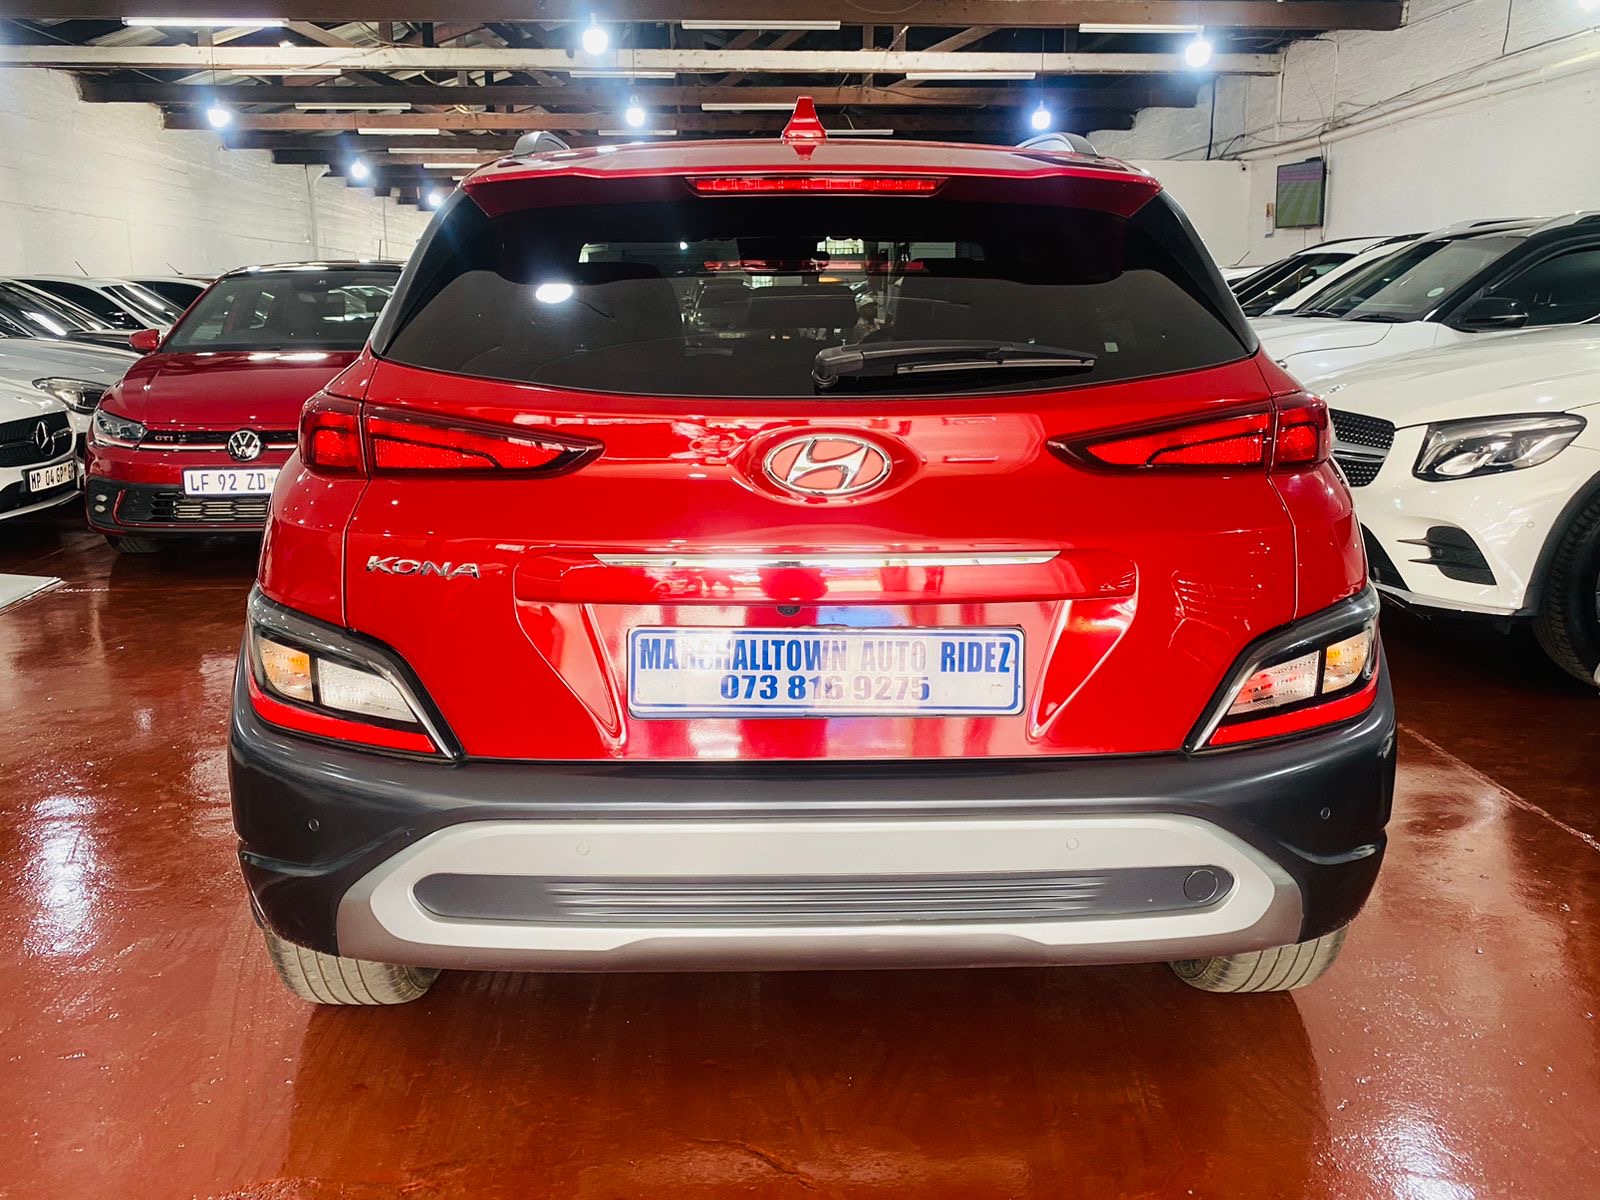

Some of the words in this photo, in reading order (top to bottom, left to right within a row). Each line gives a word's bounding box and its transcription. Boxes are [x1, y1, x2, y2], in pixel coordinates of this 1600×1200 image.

[190, 473, 209, 491] LF
[219, 473, 237, 491] 92
[246, 473, 266, 490] ZD
[366, 555, 480, 580] KONA
[860, 640, 927, 672] AUTO
[940, 641, 1011, 673] RIDEZ
[720, 675, 778, 700] 073
[787, 675, 844, 700] 816
[853, 675, 930, 701] 9275
